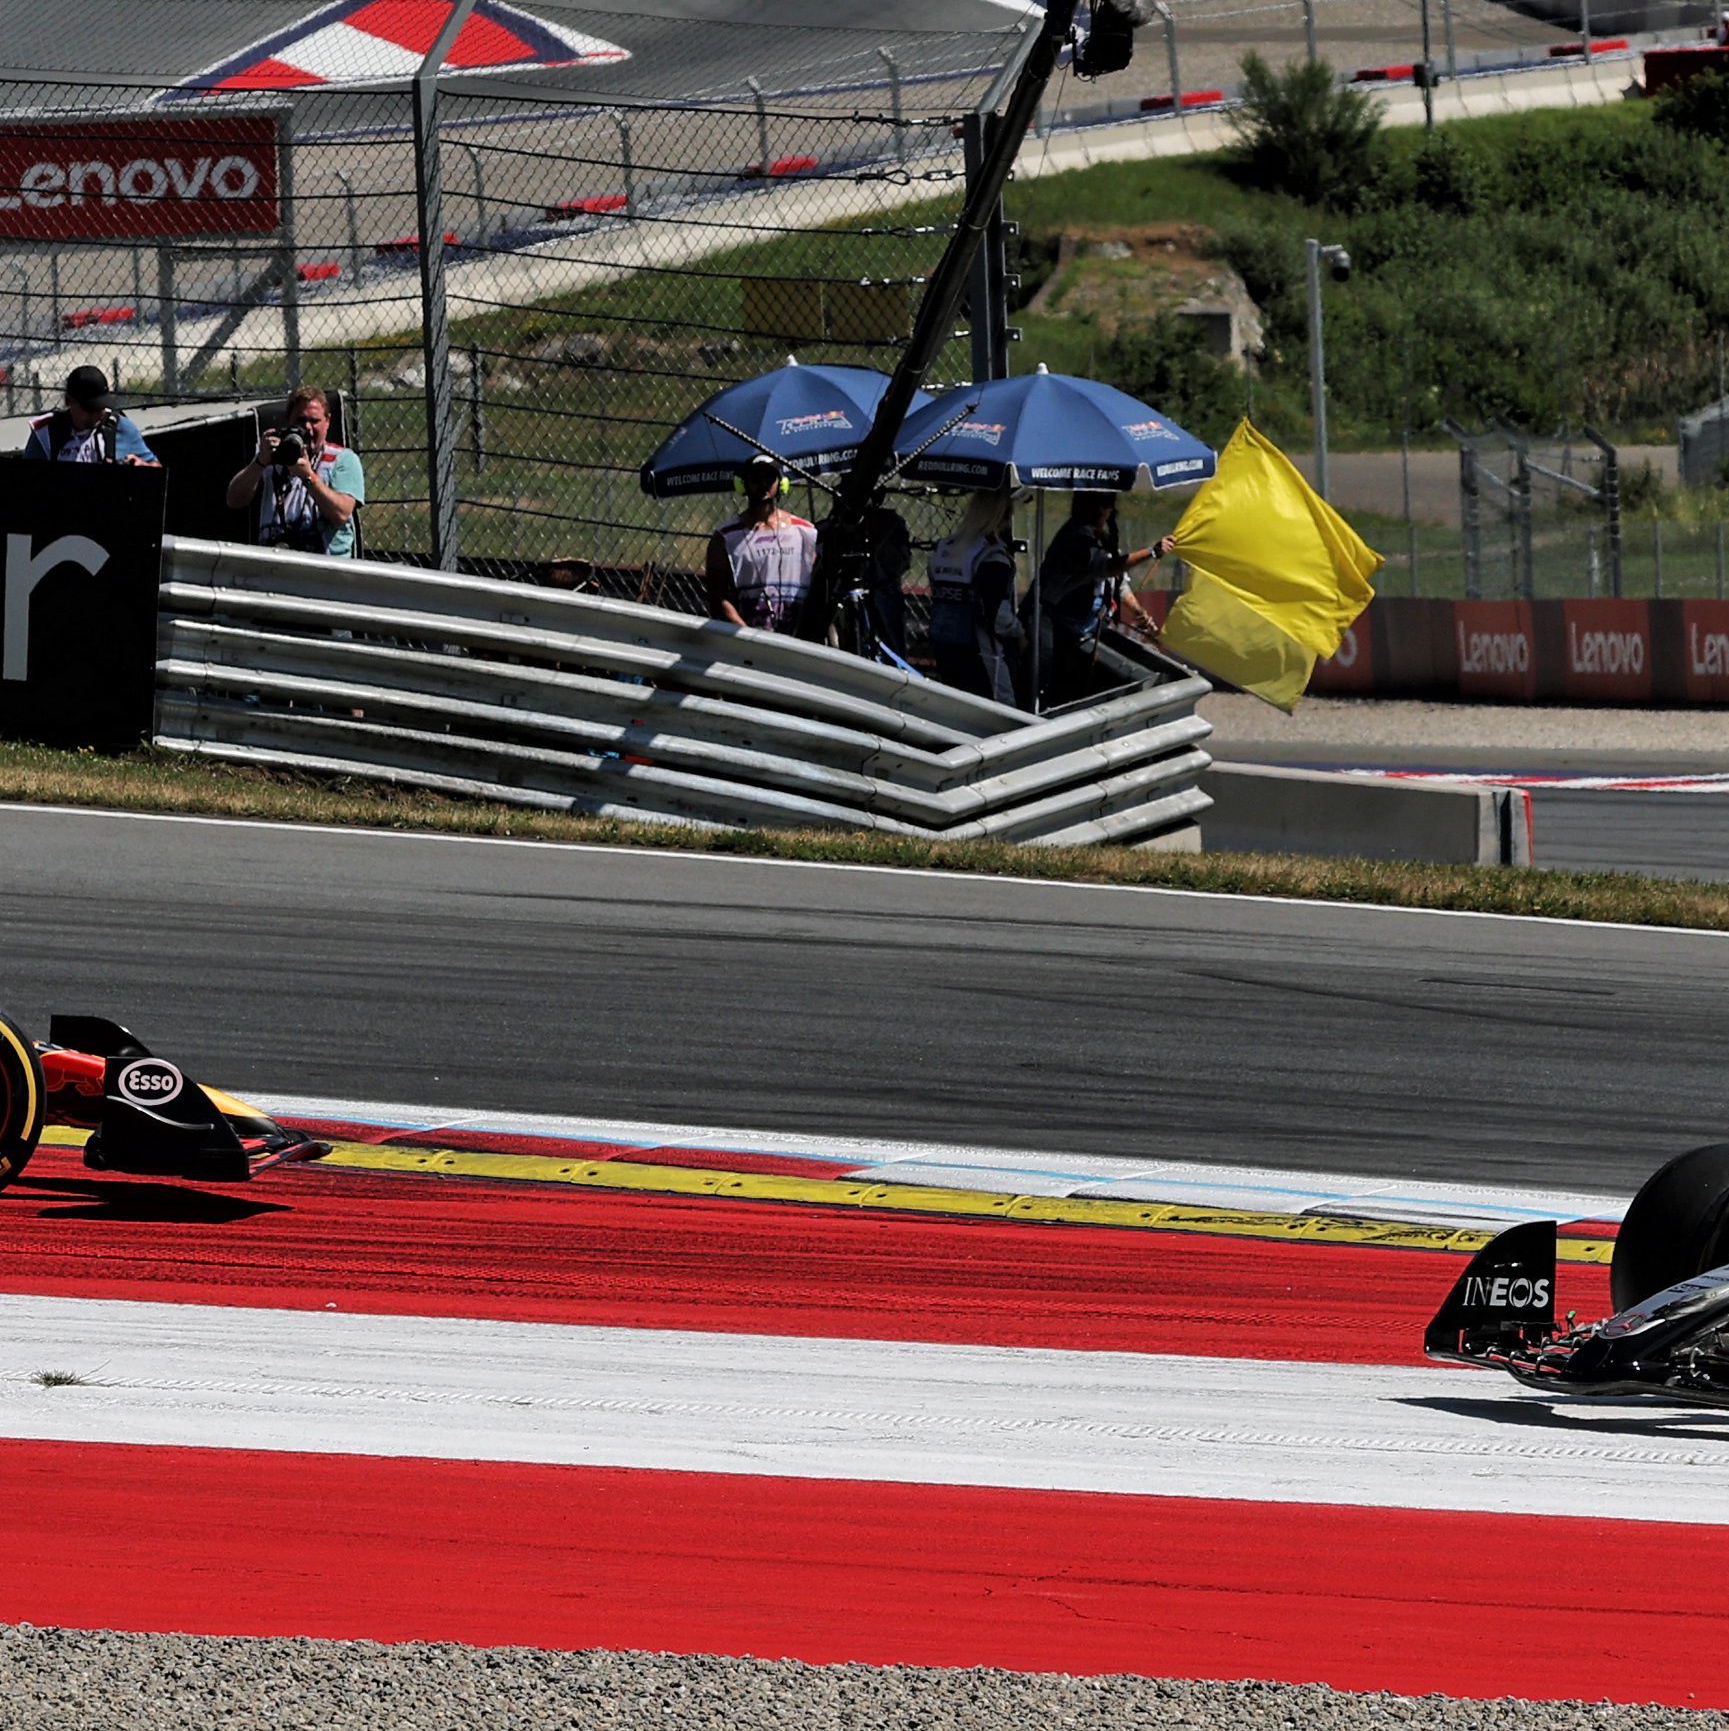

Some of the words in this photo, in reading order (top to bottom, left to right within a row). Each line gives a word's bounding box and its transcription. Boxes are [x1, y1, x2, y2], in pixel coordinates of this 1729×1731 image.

[666, 472, 700, 487] WELCOME
[1030, 467, 1072, 479] WELCOME
[1073, 467, 1096, 480] RACE
[1097, 468, 1120, 482] FANS
[1459, 621, 1529, 672] Lenovo
[1569, 621, 1643, 674] Lenovo
[128, 1068, 174, 1092] Esso
[1461, 1276, 1550, 1310] INEOS
